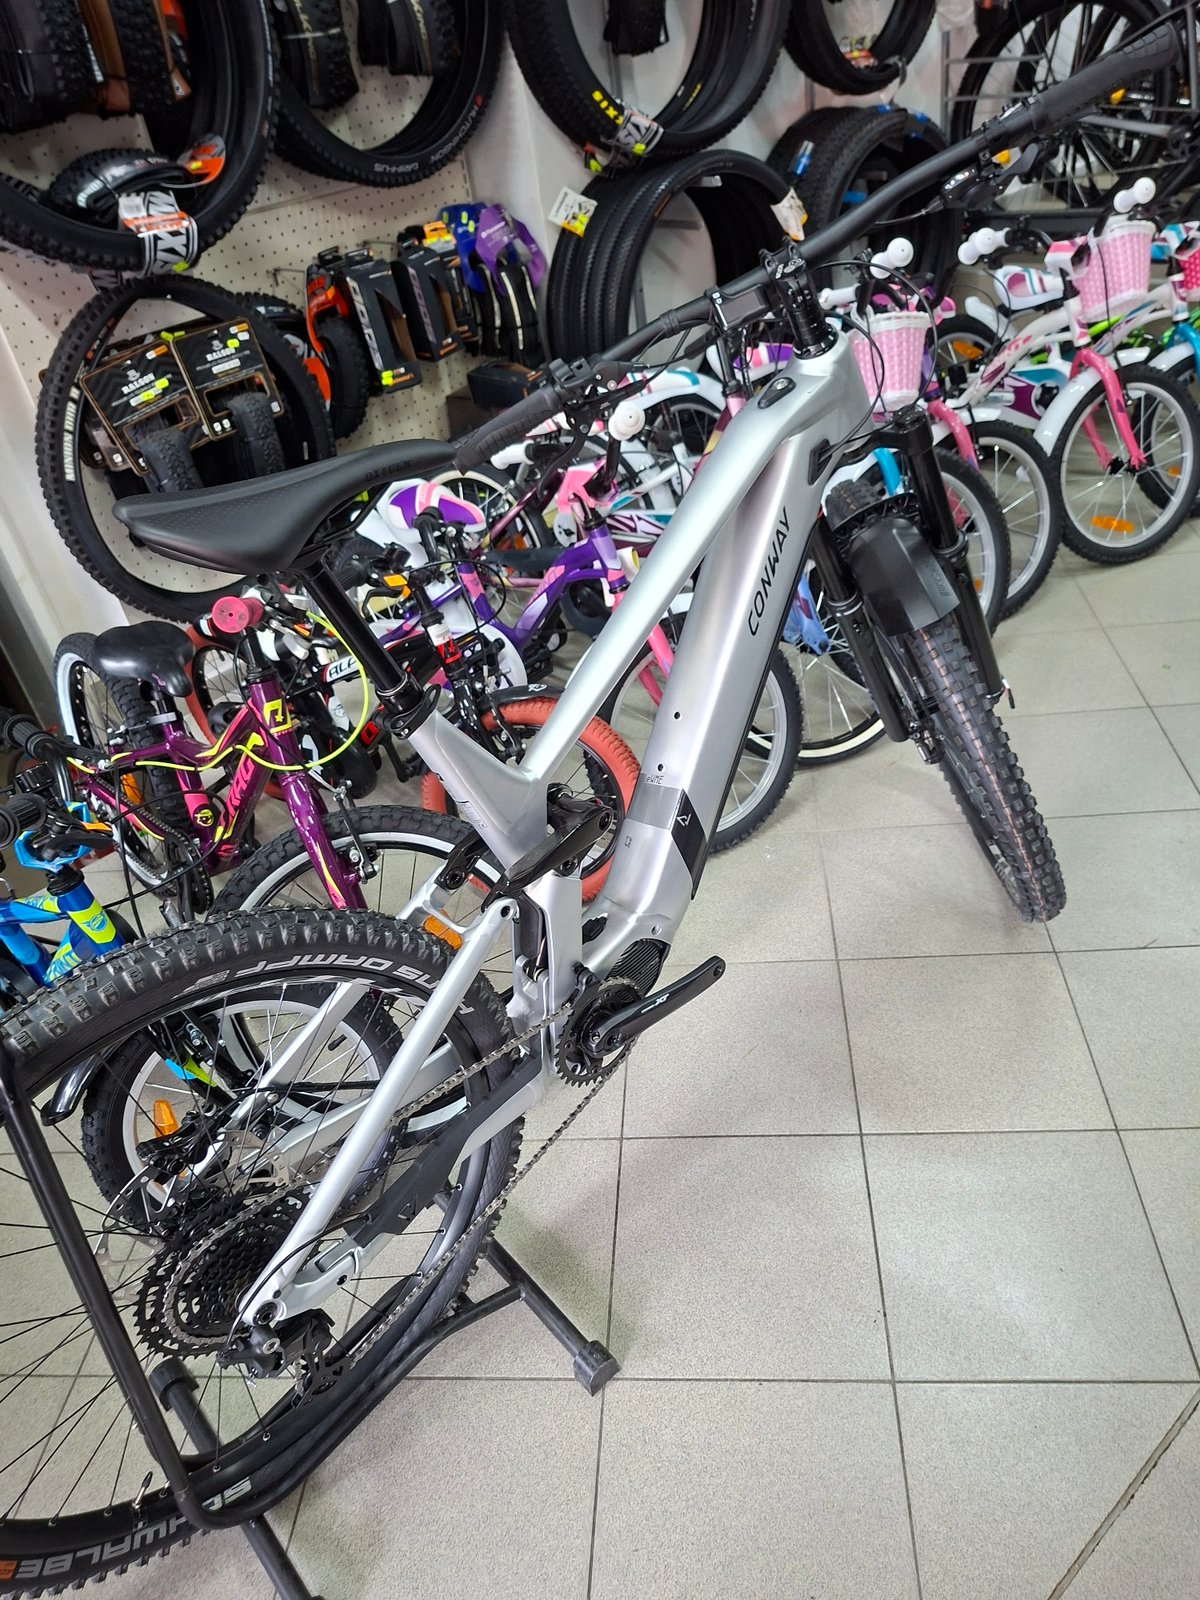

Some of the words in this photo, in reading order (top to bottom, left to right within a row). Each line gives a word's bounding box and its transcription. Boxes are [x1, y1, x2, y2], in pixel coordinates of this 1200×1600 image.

[63, 430, 77, 482] MINION
[366, 460, 411, 481] OXYGEN
[747, 506, 791, 636] CONWAY
[232, 953, 395, 979] DAMPF
